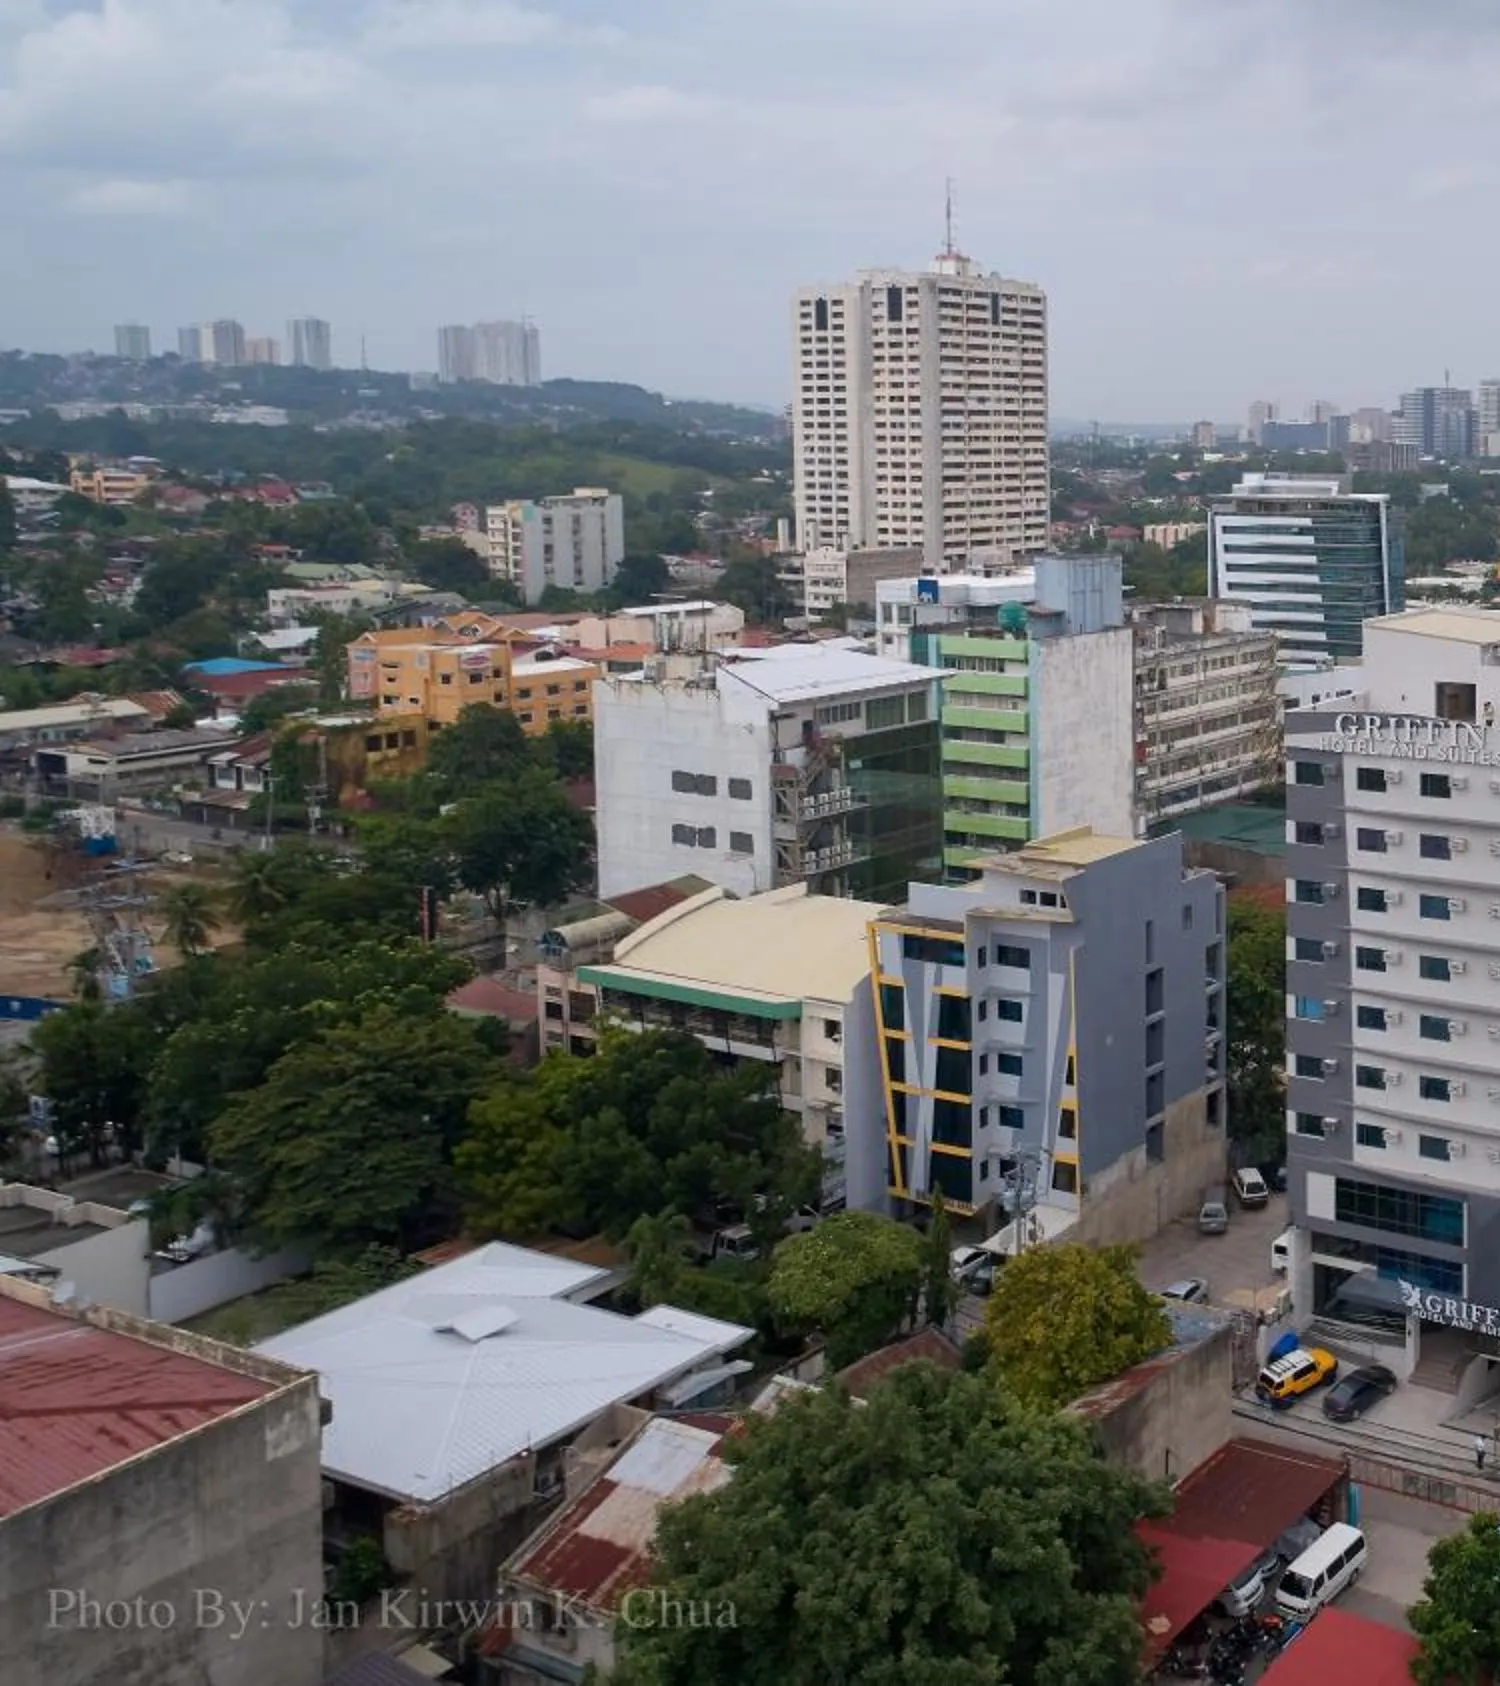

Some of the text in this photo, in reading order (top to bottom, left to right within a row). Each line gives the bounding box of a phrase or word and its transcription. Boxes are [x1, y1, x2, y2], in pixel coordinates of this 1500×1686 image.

[1335, 713, 1487, 750] GRIFFIN
[1320, 735, 1377, 755] HOTEL
[1391, 741, 1427, 760] AND
[1451, 1318, 1474, 1331] AND
